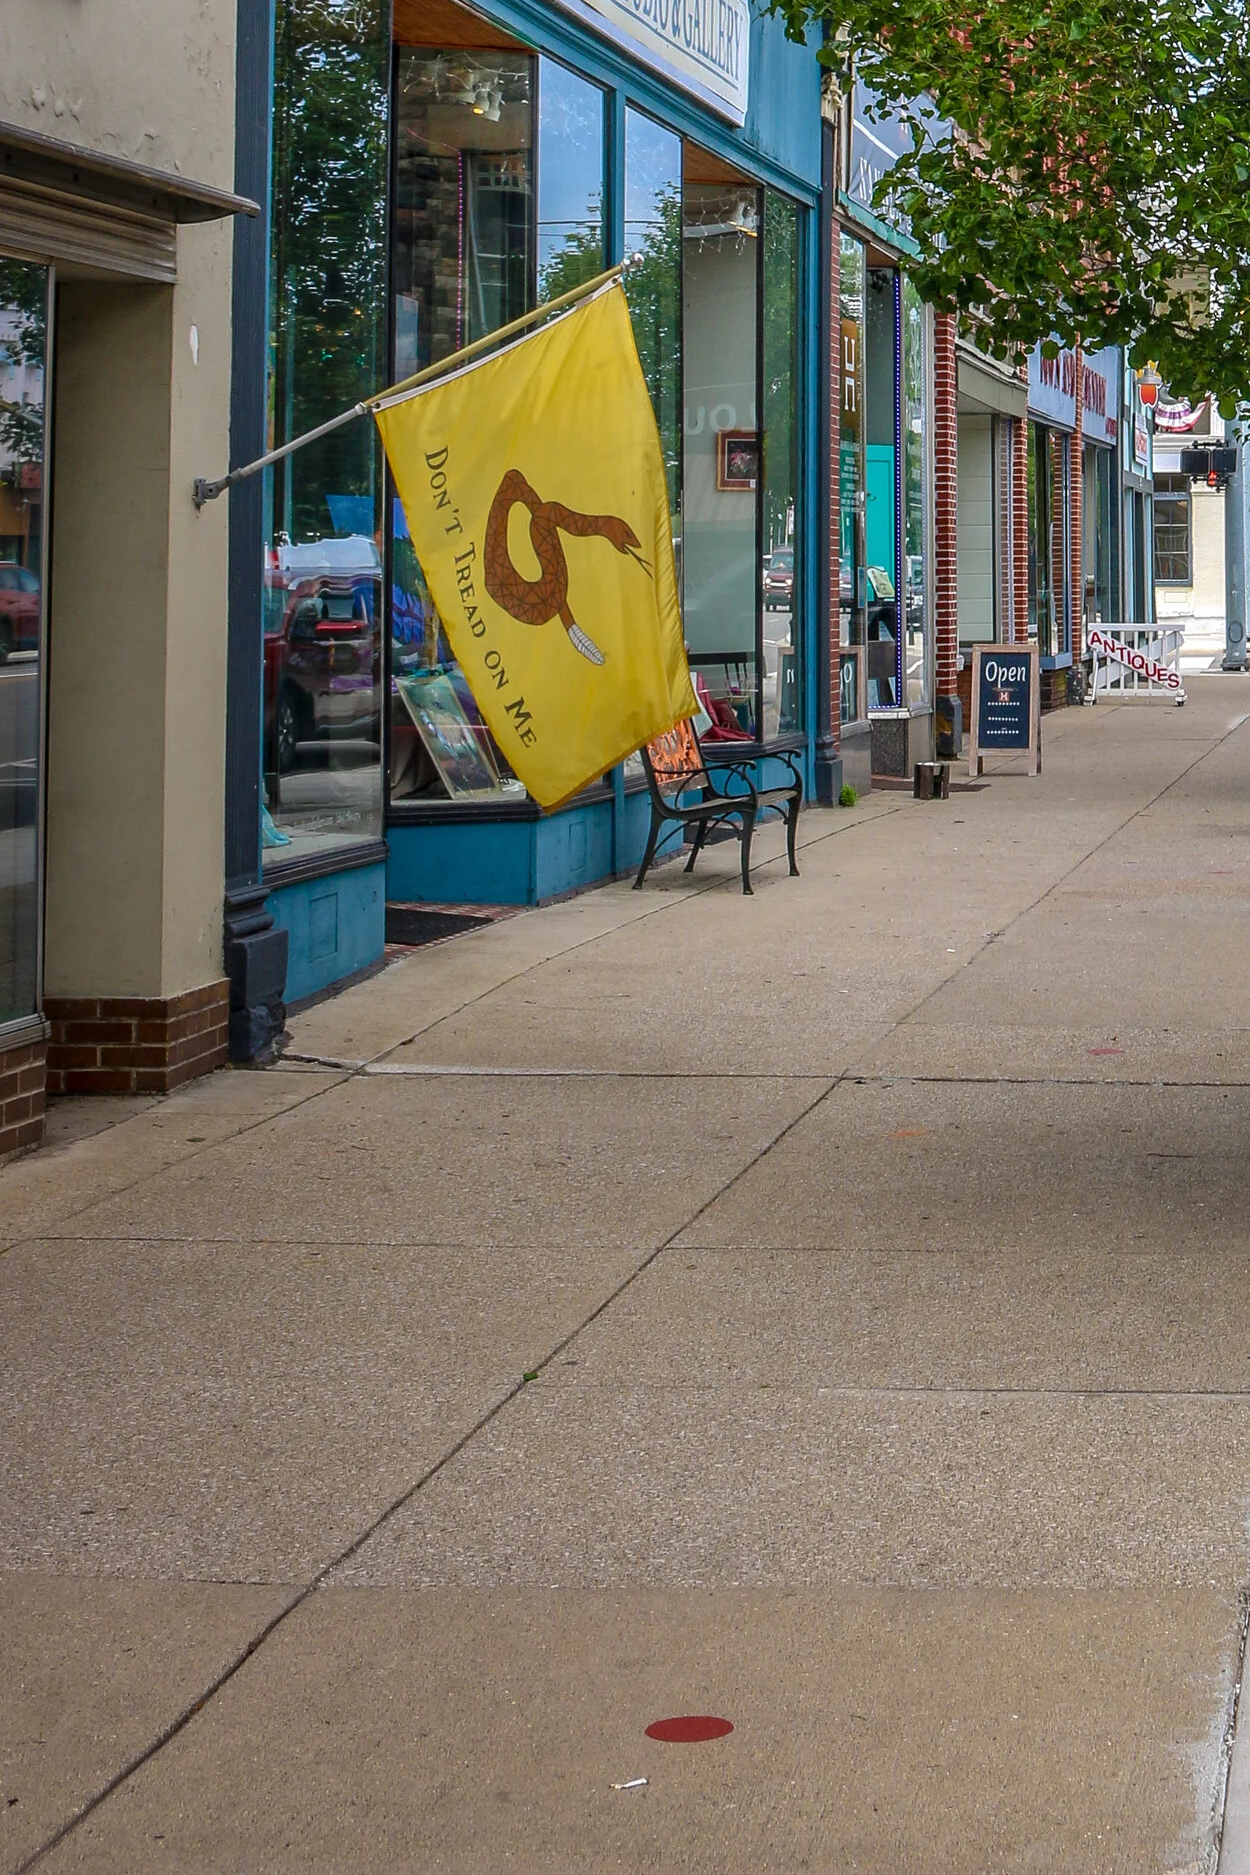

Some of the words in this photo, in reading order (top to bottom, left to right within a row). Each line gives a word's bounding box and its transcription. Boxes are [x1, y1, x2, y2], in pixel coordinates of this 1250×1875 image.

[424, 445, 464, 535] DON'T
[454, 541, 487, 639] TREAD
[503, 696, 537, 749] ME
[985, 661, 1026, 688] Open
[1090, 631, 1180, 688] ANTIQUES
